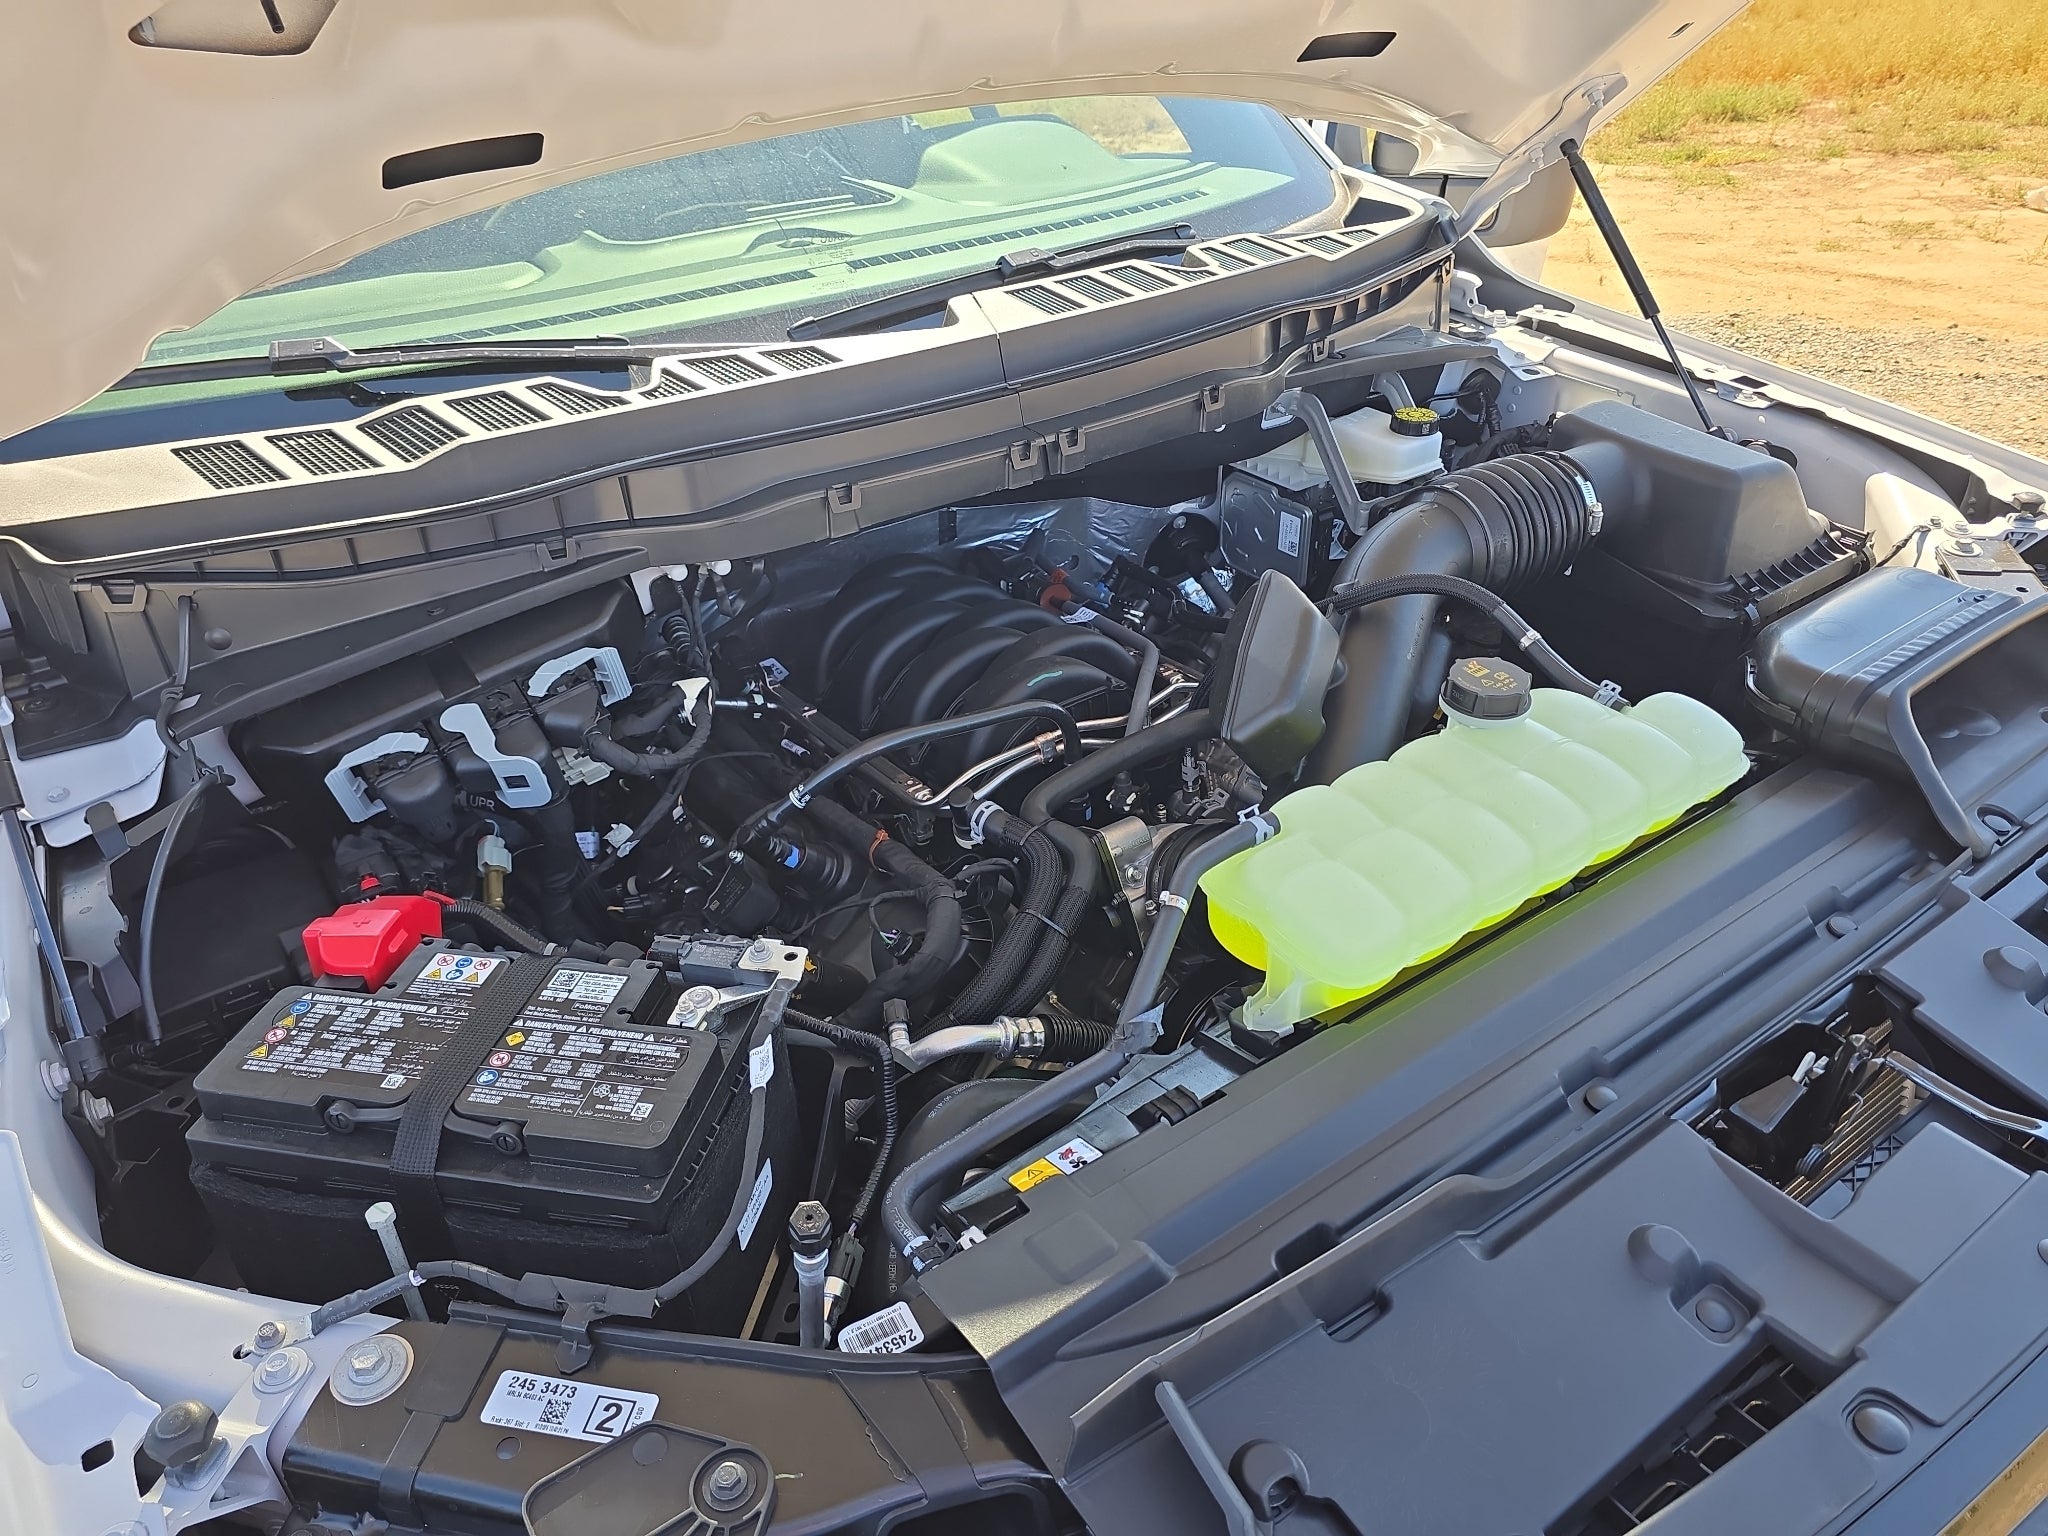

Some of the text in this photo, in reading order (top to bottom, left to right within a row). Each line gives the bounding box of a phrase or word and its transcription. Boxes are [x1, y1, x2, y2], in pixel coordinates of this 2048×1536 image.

[470, 794, 495, 812] UPR
[312, 993, 428, 1012] DANGER/POISON PELIGRO/VENENO
[574, 1003, 606, 1012] FoMoCo
[524, 1020, 644, 1040] DANGER/POISON PELIGRO/VENENO
[508, 1375, 578, 1399] 245 3473
[594, 1402, 623, 1433] 2
